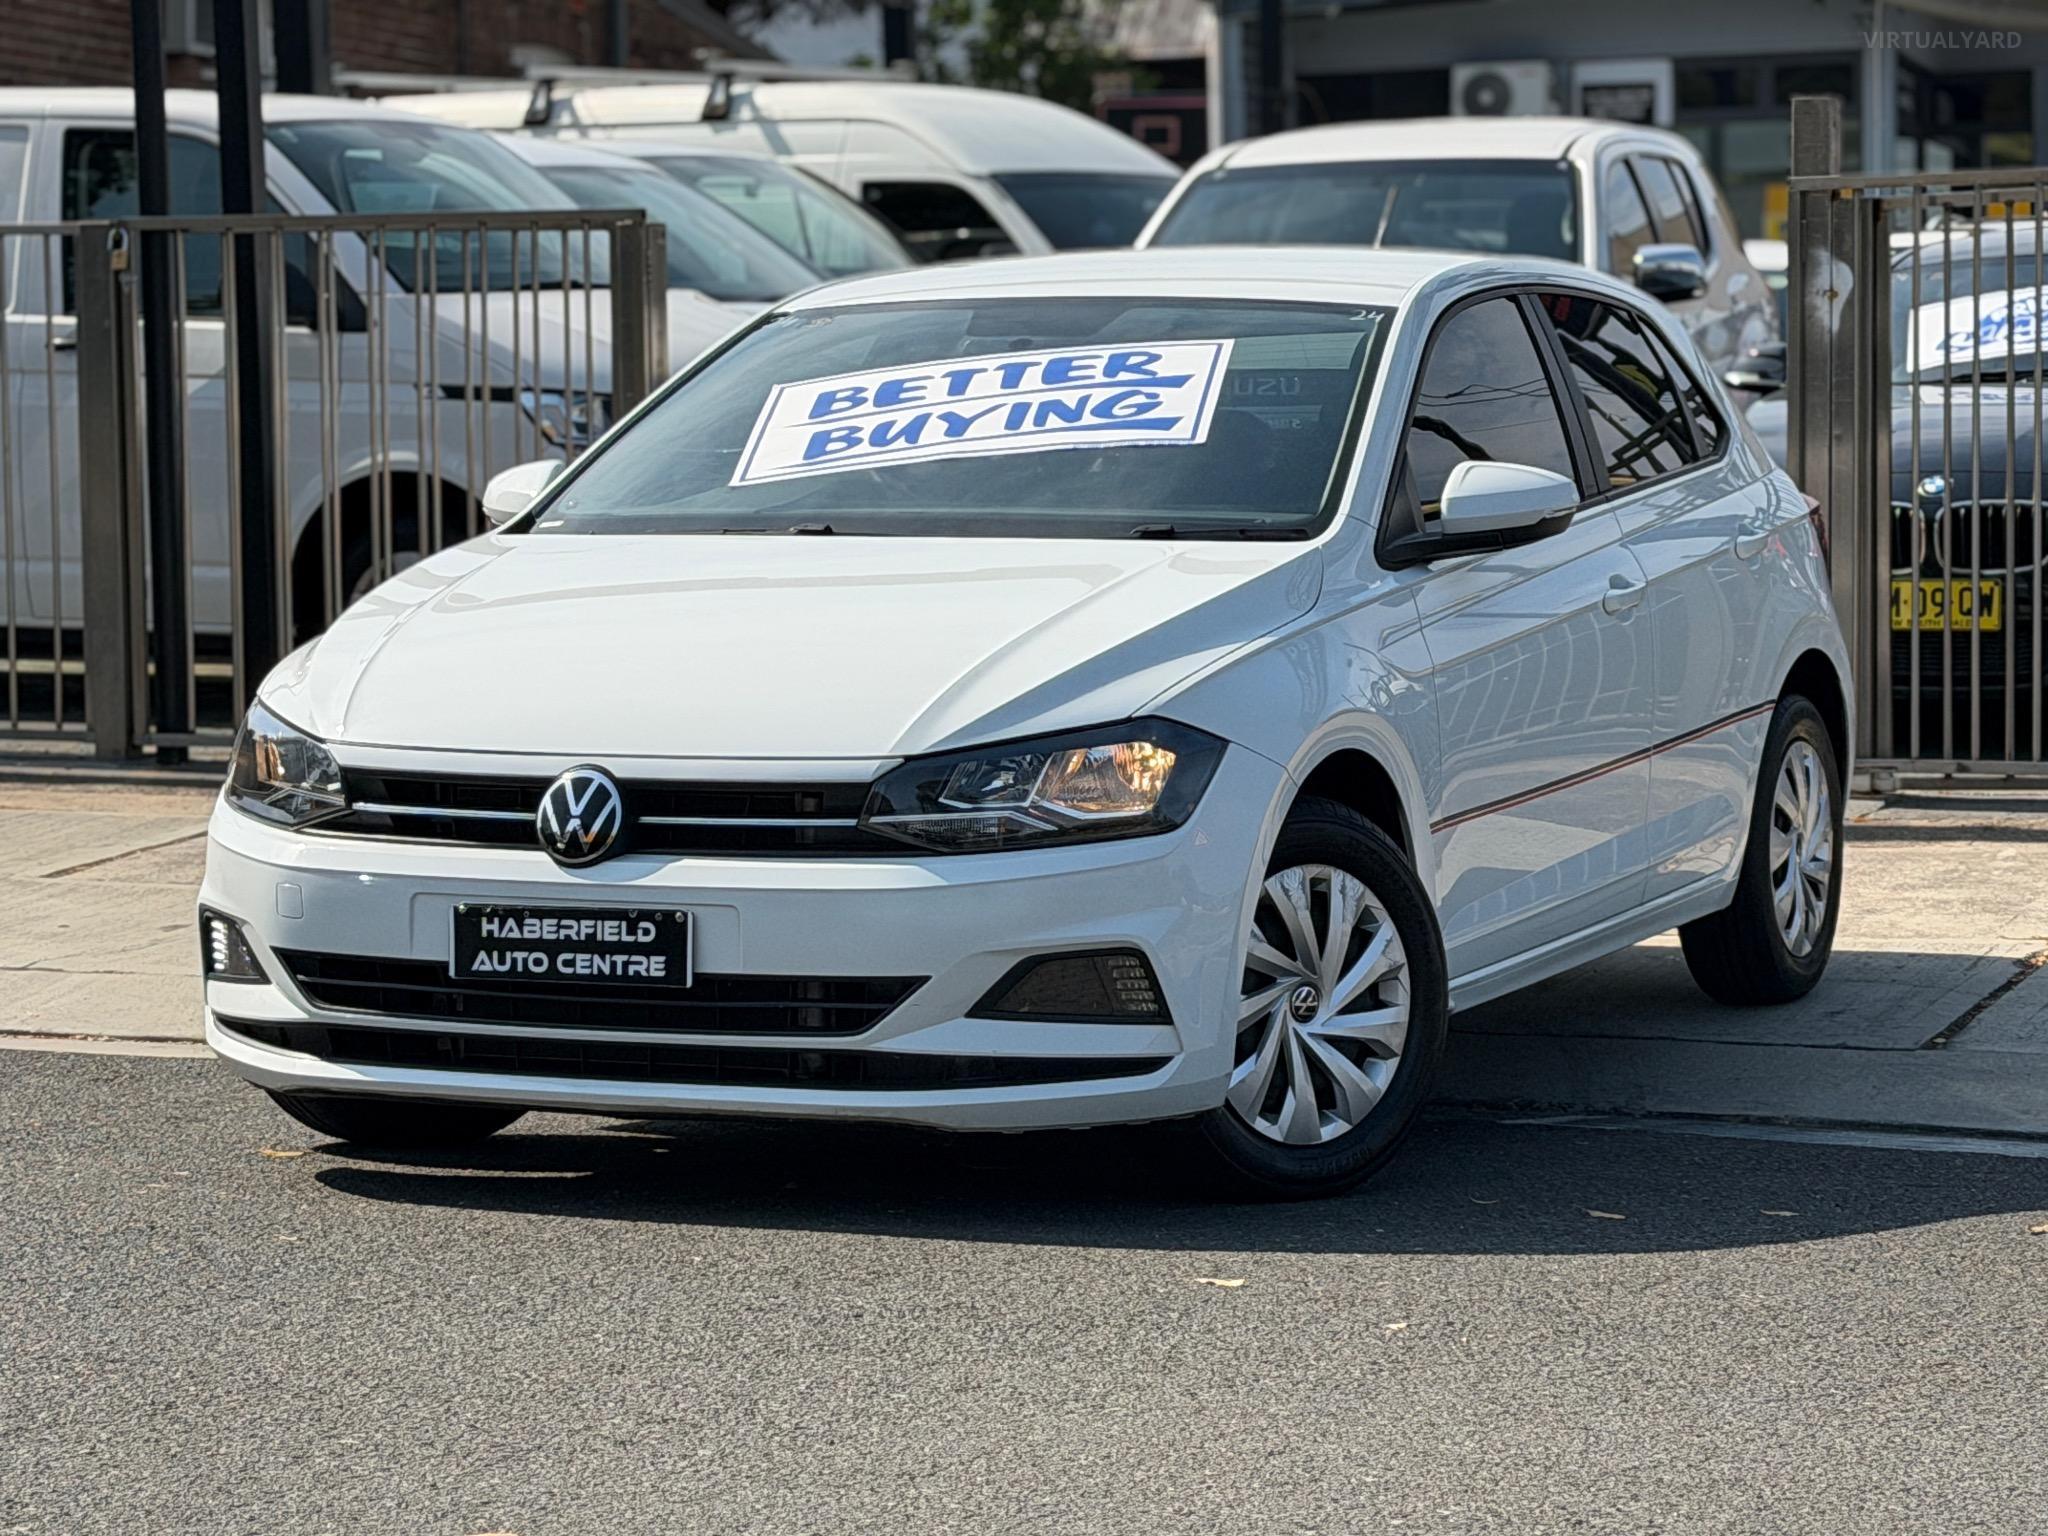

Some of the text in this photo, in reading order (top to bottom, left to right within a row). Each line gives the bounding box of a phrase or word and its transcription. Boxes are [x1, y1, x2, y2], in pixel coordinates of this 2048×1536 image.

[808, 350, 1164, 419] BETTER
[802, 389, 1164, 460] BUYING
[481, 917, 657, 942] HABERFIELD
[471, 950, 667, 977] AUTO CENTRE
